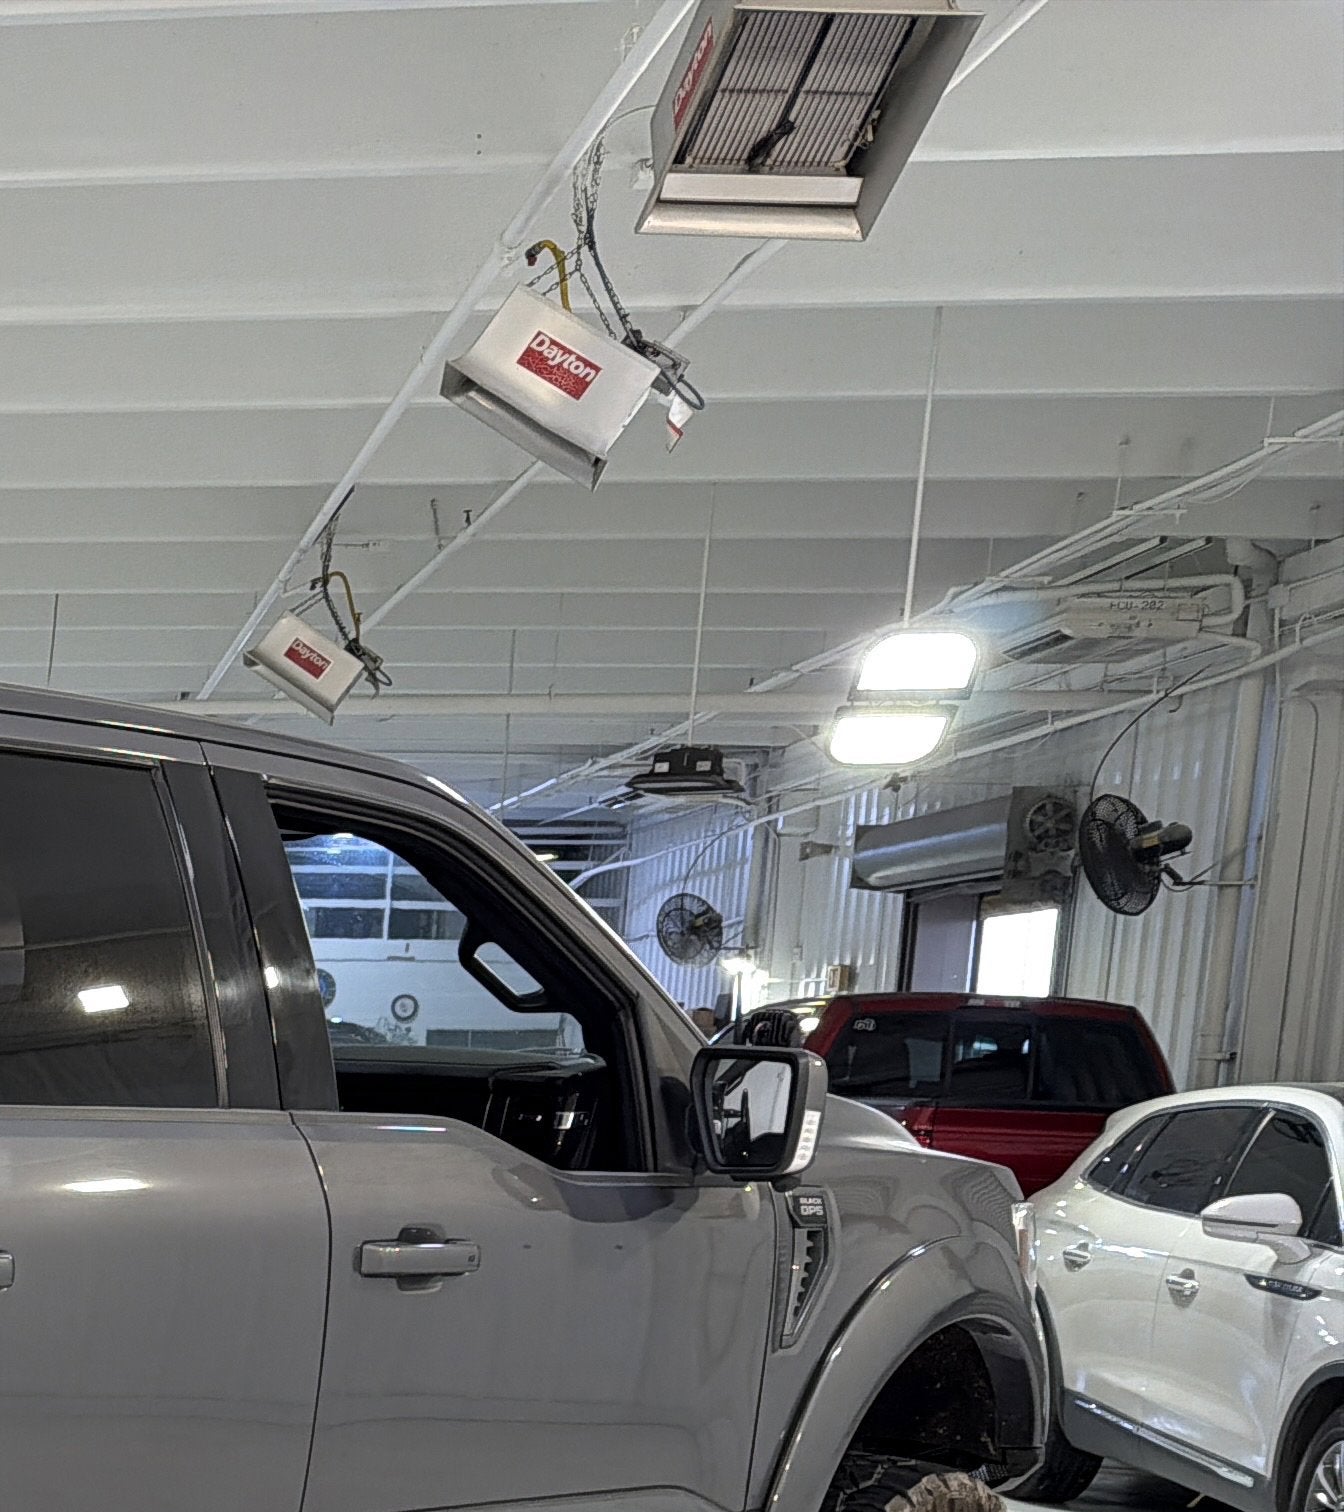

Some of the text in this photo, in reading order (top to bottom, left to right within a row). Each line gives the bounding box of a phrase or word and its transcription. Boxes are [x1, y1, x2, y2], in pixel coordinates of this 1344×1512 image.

[529, 333, 597, 383] Dayton
[293, 640, 329, 670] Dayton
[800, 1205, 824, 1216] OPS
